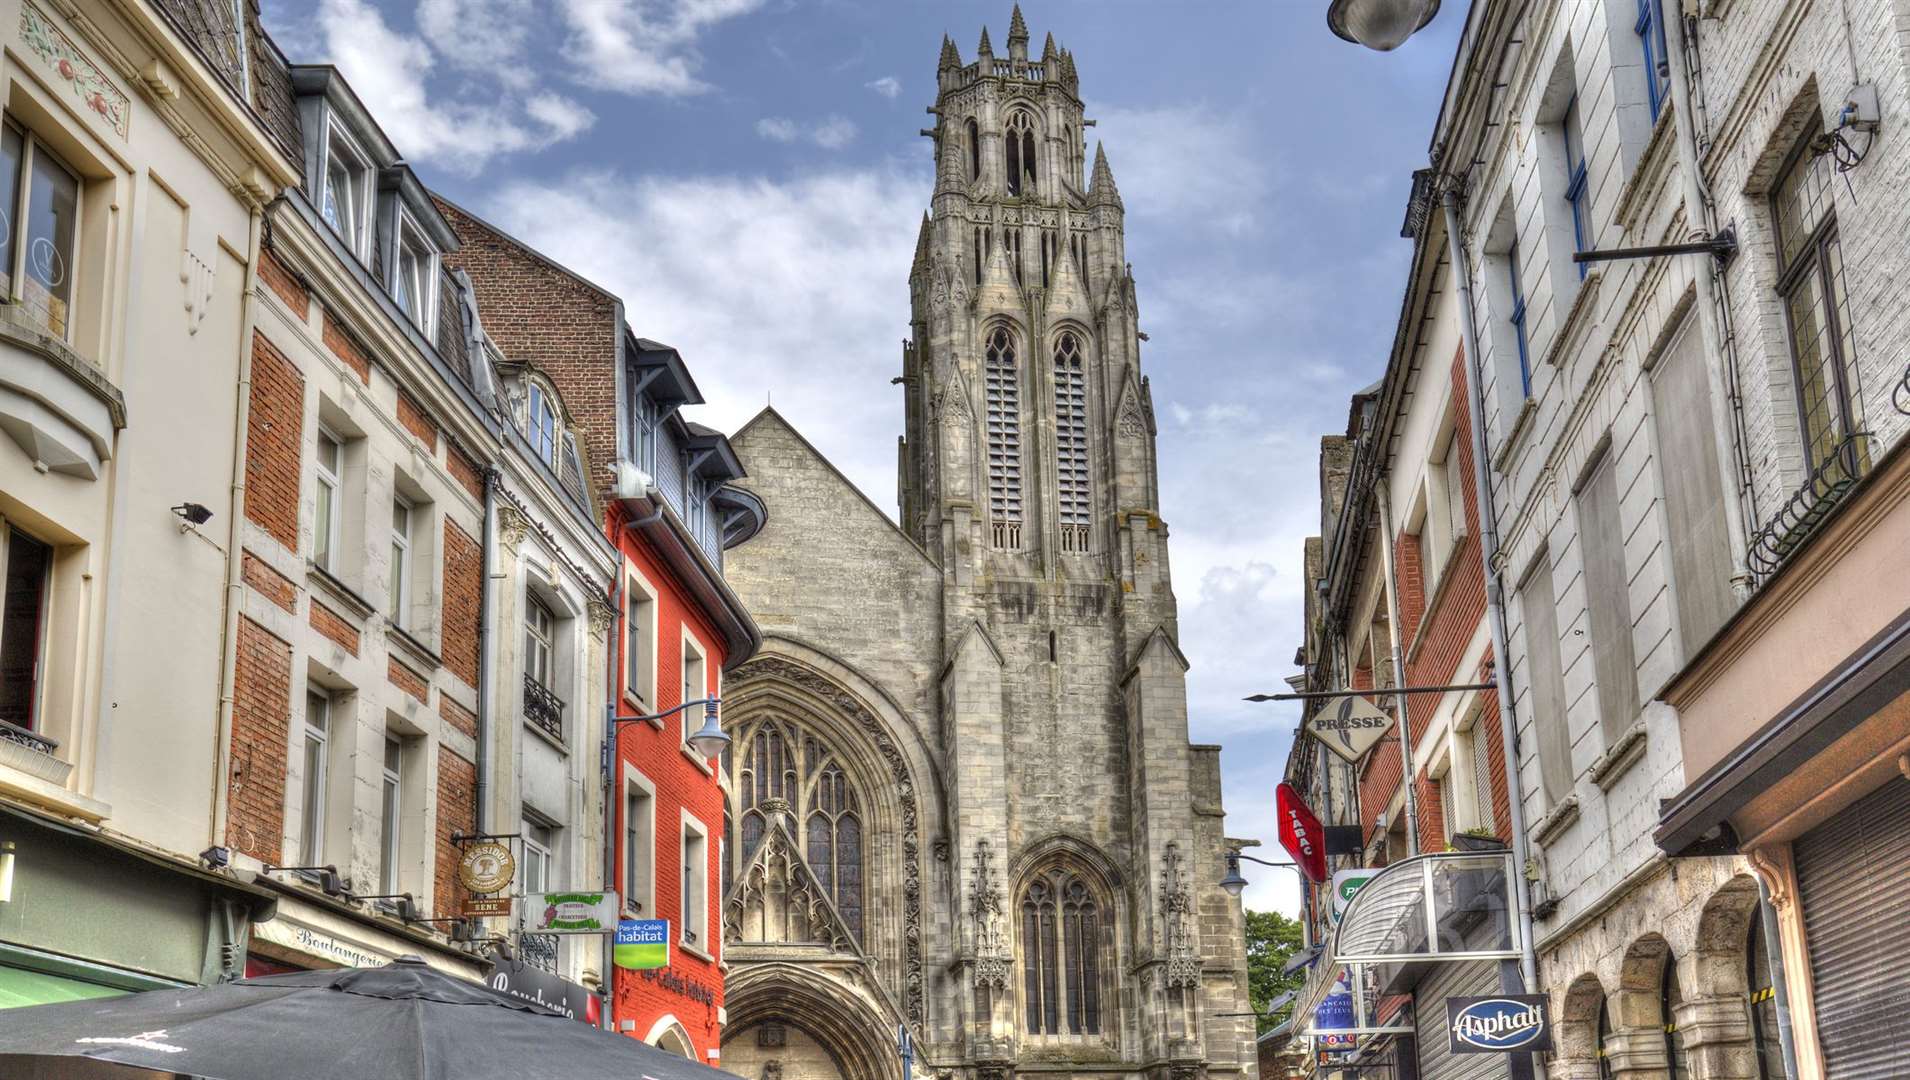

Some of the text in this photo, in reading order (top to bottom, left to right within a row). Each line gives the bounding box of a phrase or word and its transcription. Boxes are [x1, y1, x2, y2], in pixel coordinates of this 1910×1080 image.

[1315, 716, 1386, 732] PRESSE
[1288, 809, 1313, 856] TABAC
[1345, 886, 1360, 897] P
[296, 927, 384, 969] Boulangerie
[618, 931, 663, 942] habitat
[1452, 1005, 1544, 1042] Asphalt
